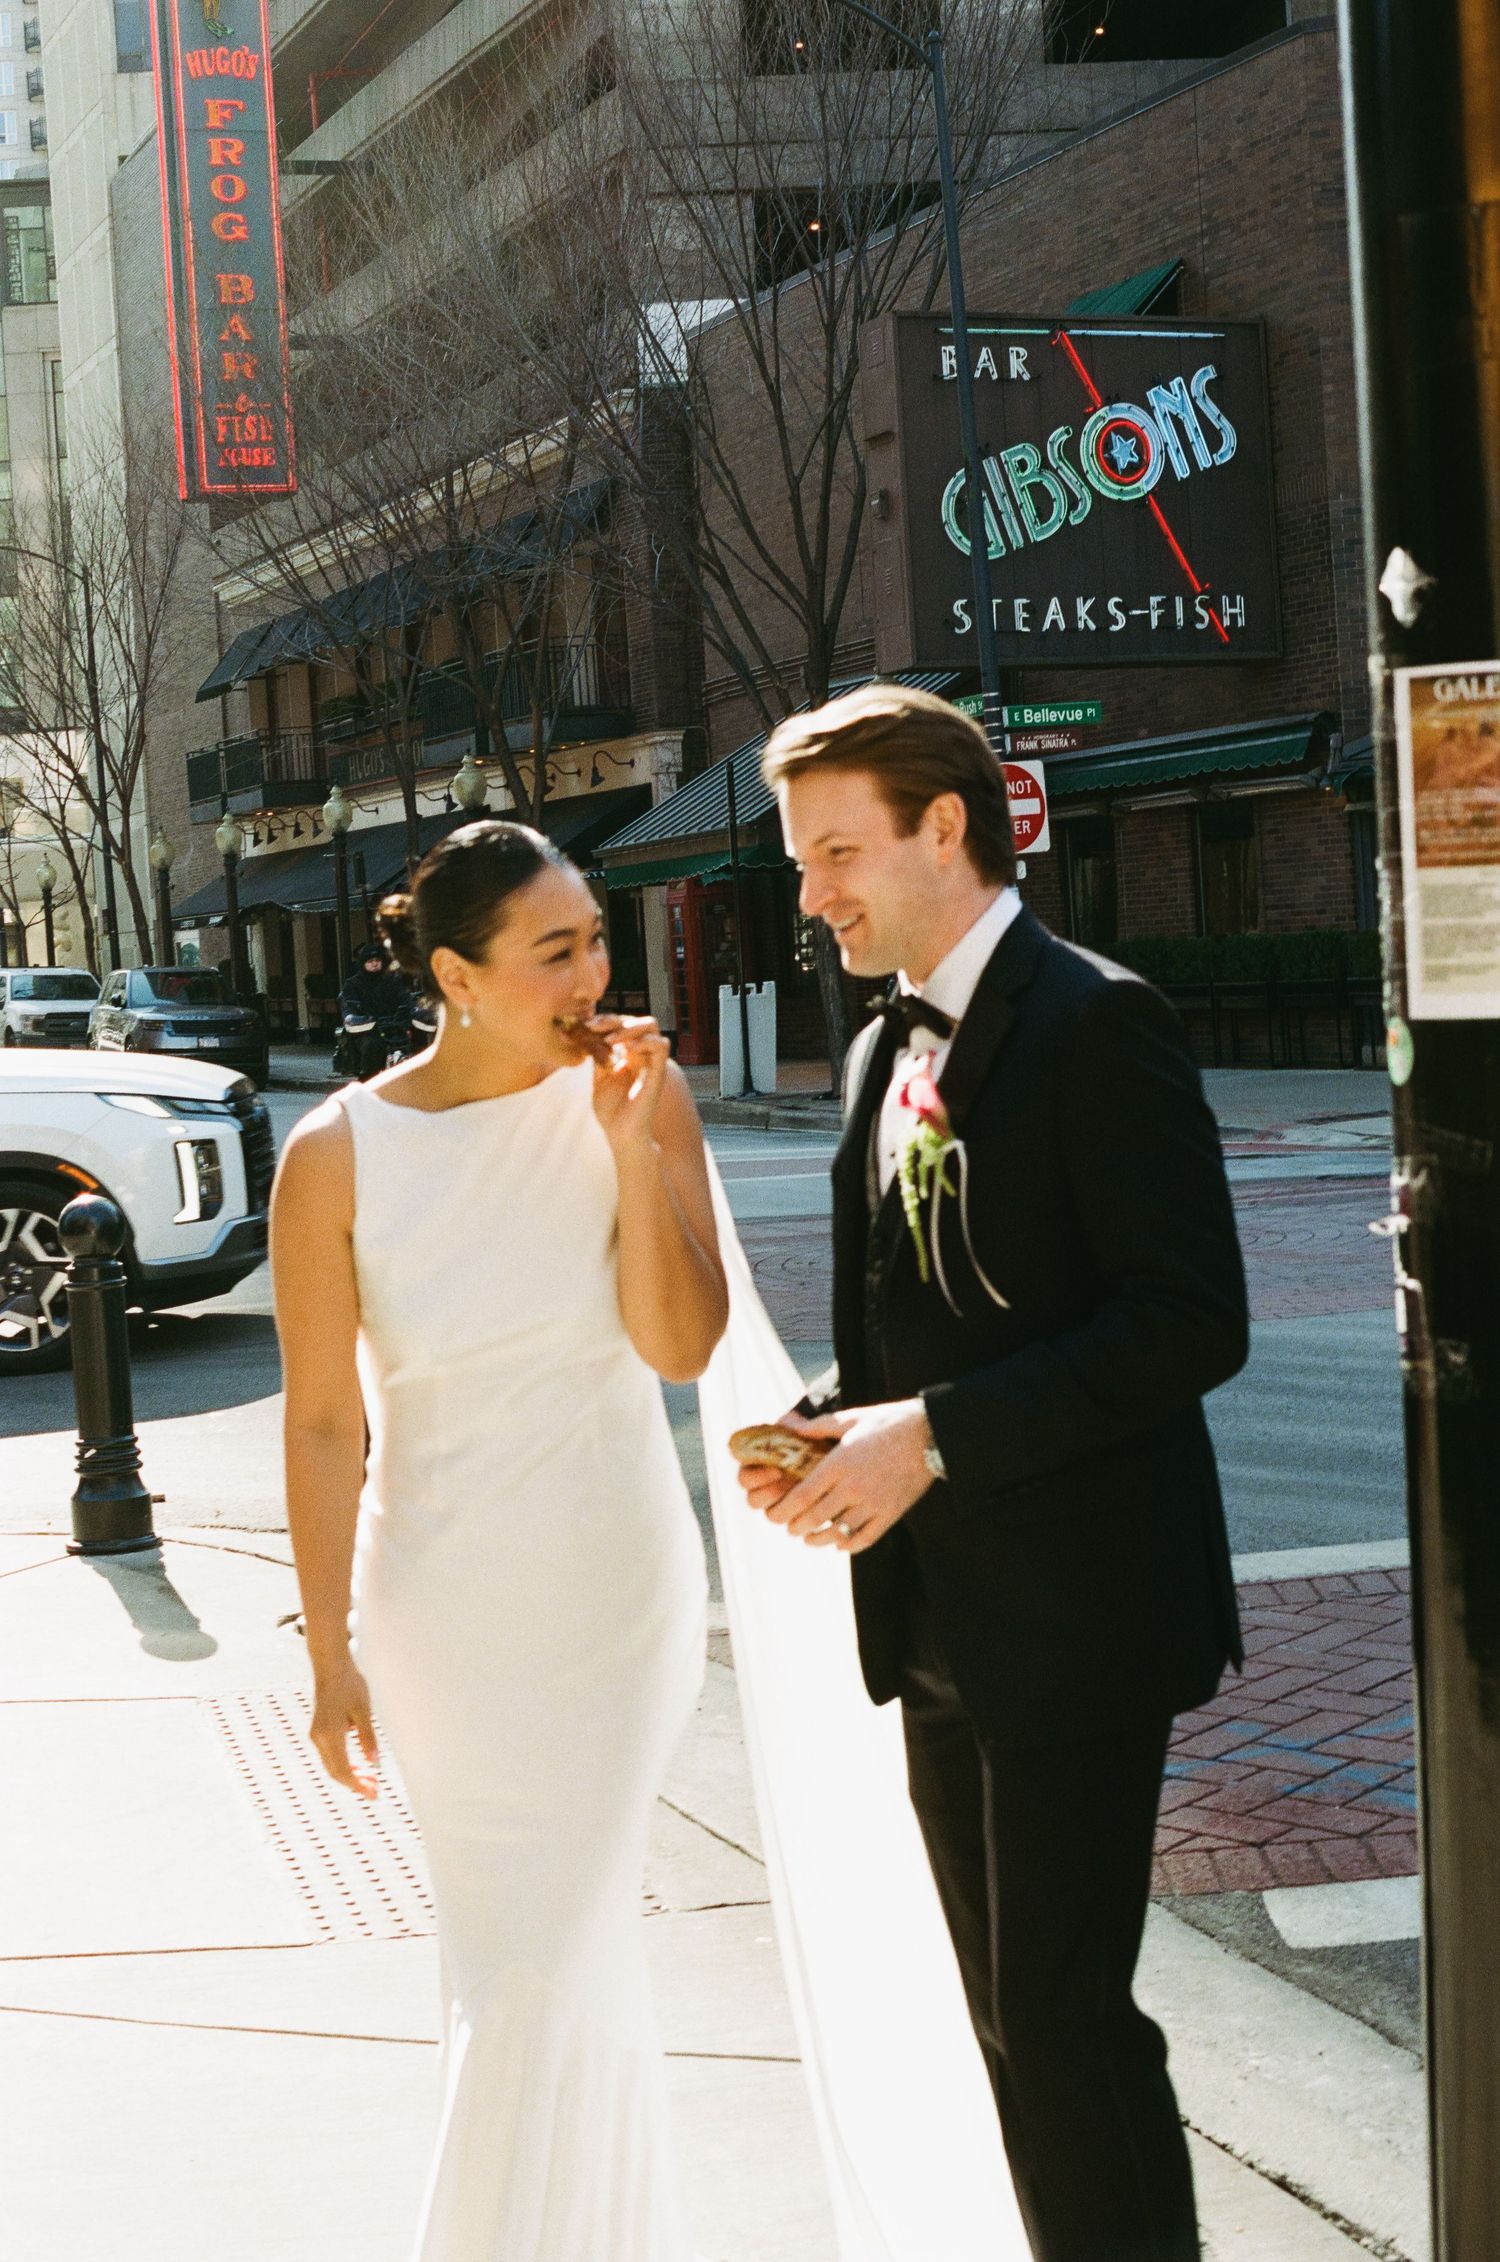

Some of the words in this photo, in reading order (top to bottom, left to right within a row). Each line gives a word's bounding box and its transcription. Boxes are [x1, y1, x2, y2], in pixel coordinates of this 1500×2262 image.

[186, 44, 259, 80] HUGO'S
[204, 98, 249, 241] FROG
[216, 273, 258, 380] BAR
[941, 345, 1031, 381] BAR
[216, 414, 273, 444] FISH
[941, 364, 1238, 560] GIBSONS
[1014, 711, 1020, 721] E
[1023, 707, 1083, 723] Bellevue
[1016, 739, 1039, 751] FRANK
[1041, 738, 1069, 750] SINATRA
[1006, 780, 1032, 795] NOT
